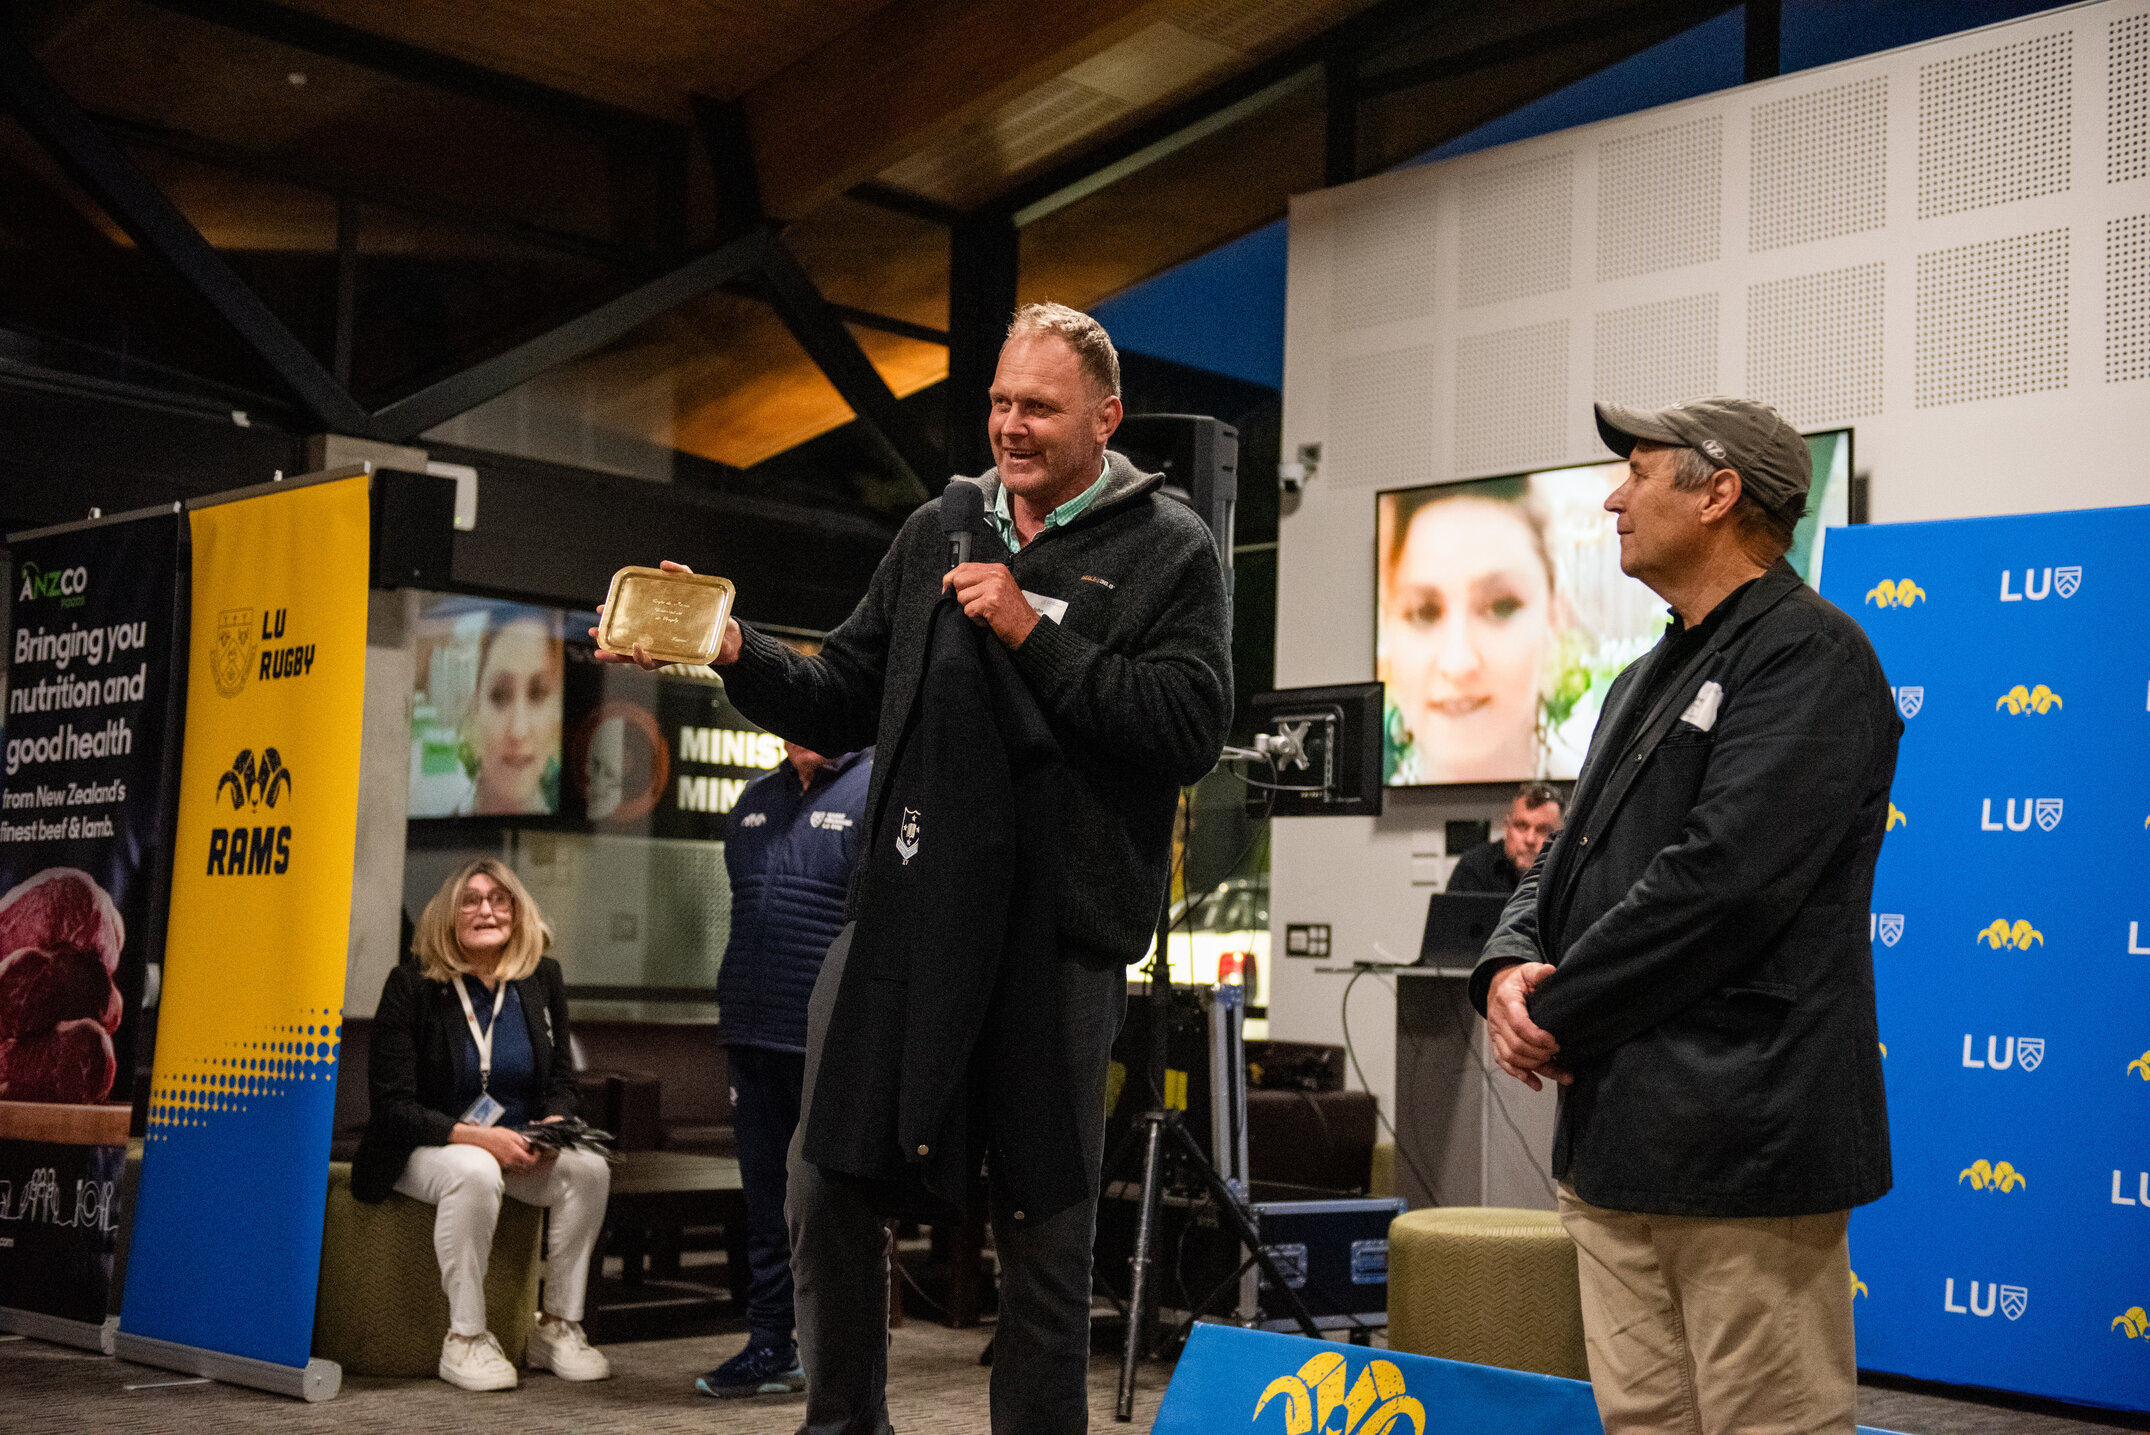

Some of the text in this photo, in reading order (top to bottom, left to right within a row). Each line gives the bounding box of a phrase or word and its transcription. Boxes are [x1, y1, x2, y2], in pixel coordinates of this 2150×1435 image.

[19, 566, 88, 602] ANZCO
[2000, 567, 2051, 602] LU
[262, 608, 287, 640] LU
[15, 621, 147, 670] Bringing you
[259, 644, 316, 681] RUGBY
[10, 662, 147, 714] nutrition and
[6, 717, 132, 775] good health
[2, 778, 127, 809] from New Zealand's
[0, 814, 114, 842] finest beef & lamb.
[1981, 798, 2033, 832] LU
[206, 825, 292, 876] RAMS
[1962, 1033, 2014, 1070] LU
[1944, 1277, 1997, 1317] LU
